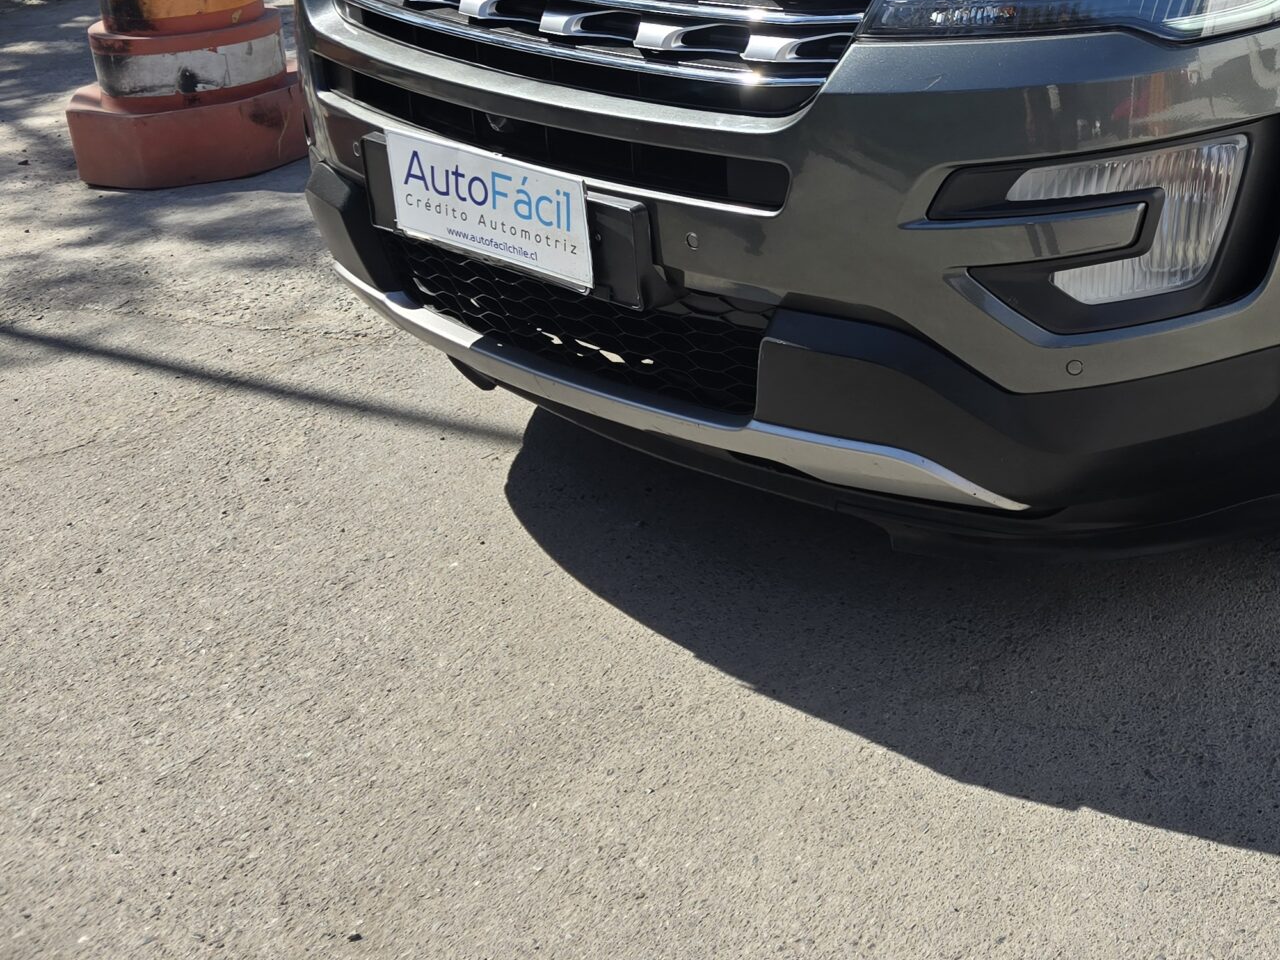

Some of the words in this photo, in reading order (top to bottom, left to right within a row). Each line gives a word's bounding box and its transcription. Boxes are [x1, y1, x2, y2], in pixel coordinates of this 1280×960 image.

[403, 149, 572, 233] AutoFácil
[405, 193, 469, 222] Crédito
[477, 208, 578, 256] Automotriz
[446, 226, 539, 262] www.autofacilchile.cl
